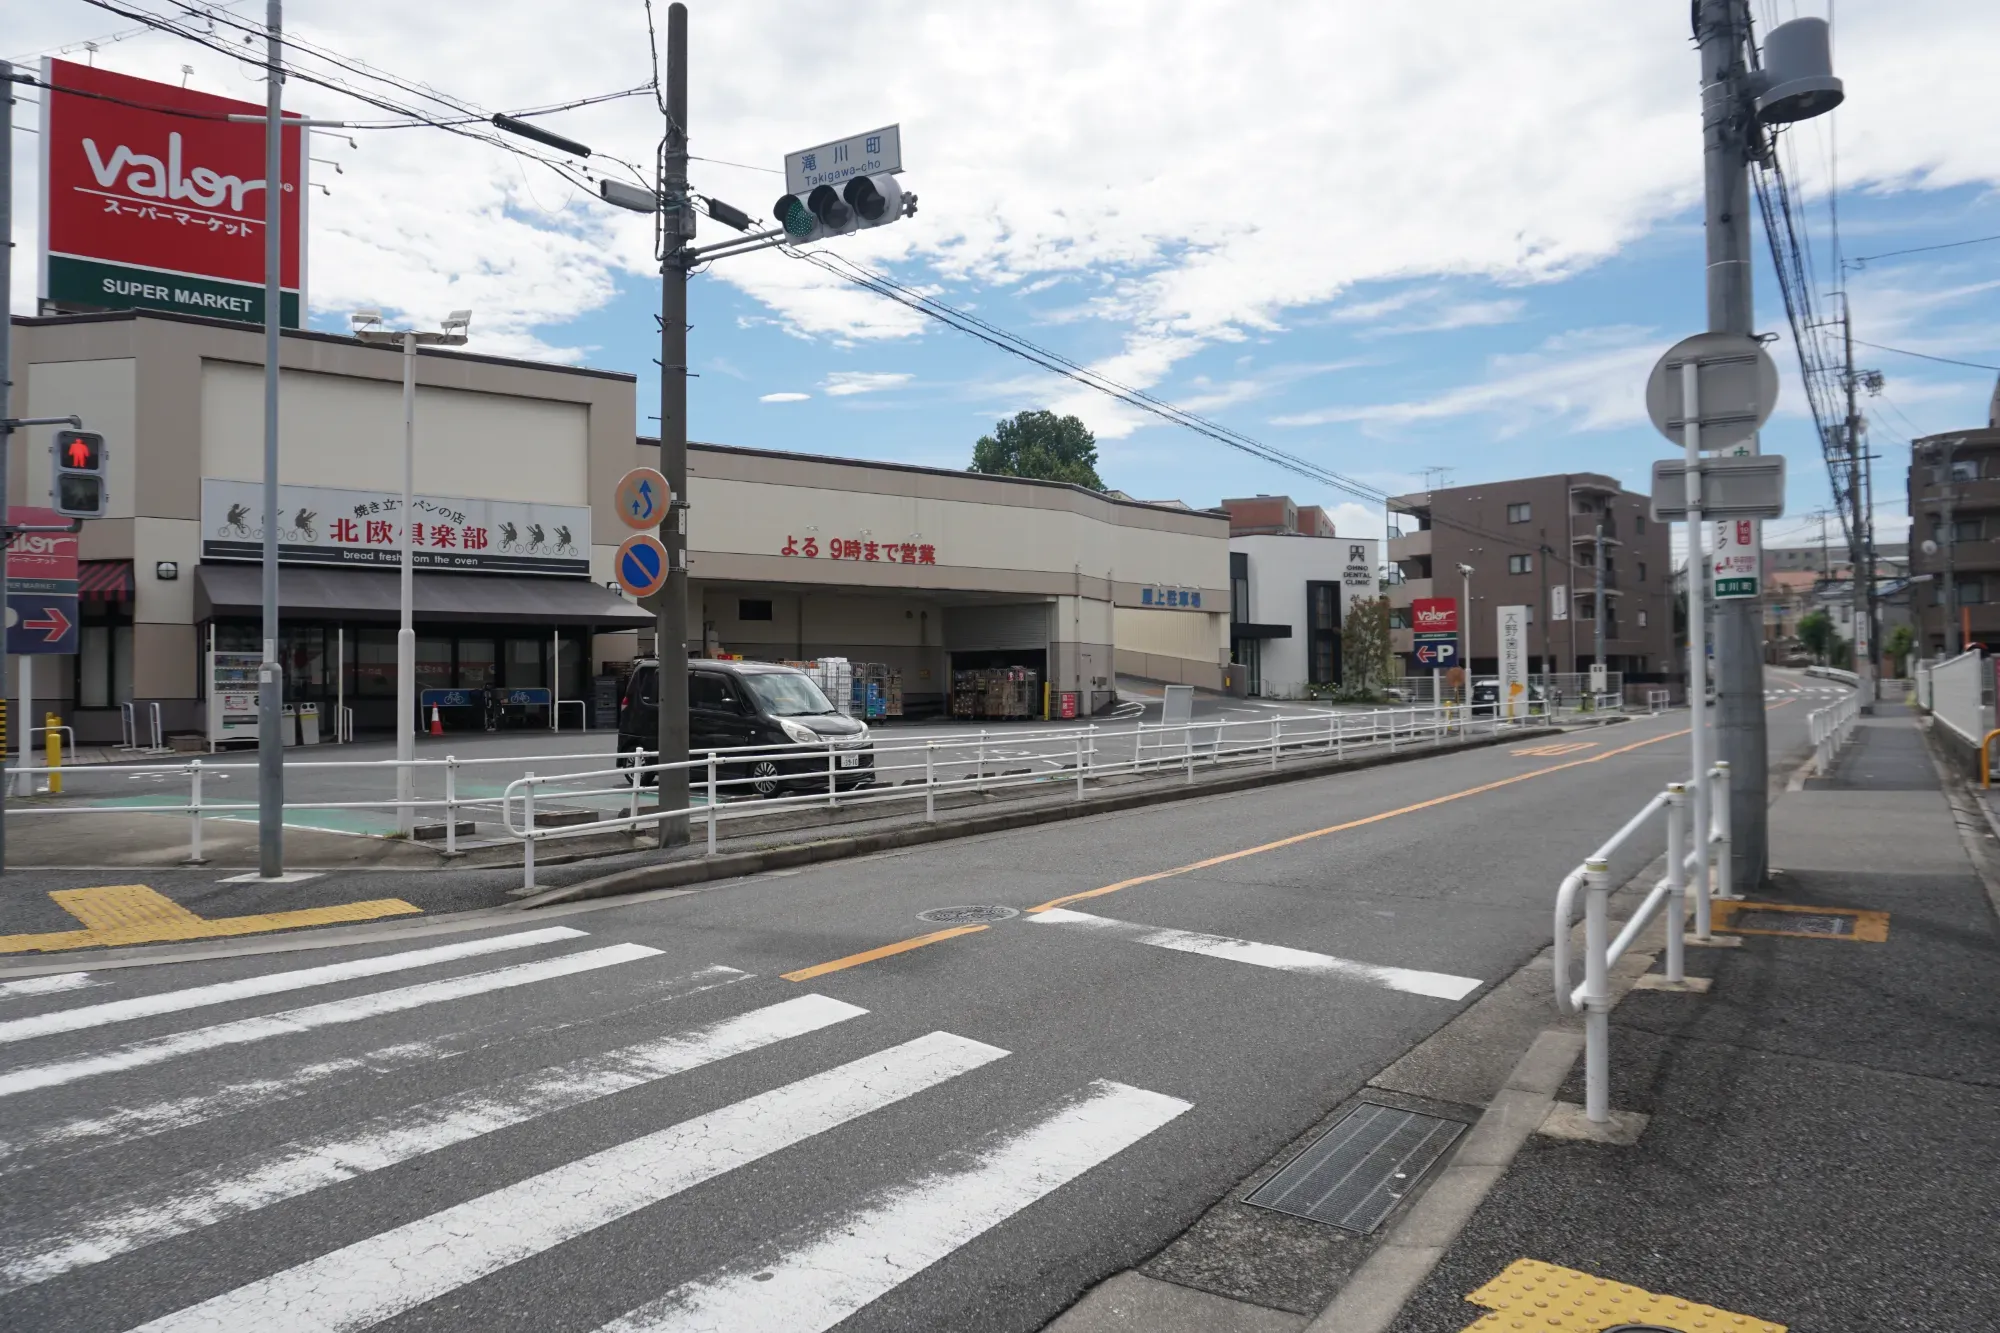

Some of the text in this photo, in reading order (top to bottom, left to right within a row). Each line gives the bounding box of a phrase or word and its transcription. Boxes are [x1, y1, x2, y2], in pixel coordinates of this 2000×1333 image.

[801, 135, 881, 173] 滝川町
[805, 159, 881, 186] Takigawa-cho
[103, 198, 253, 237] スーパーマーケット
[102, 278, 253, 313] SUPER MARKET
[343, 550, 374, 561] bread
[434, 555, 450, 564] the
[454, 558, 478, 566] oven
[781, 535, 936, 565] よる 9時まで営業
[1343, 571, 1372, 579] DENTAL
[1437, 644, 1454, 663] P
